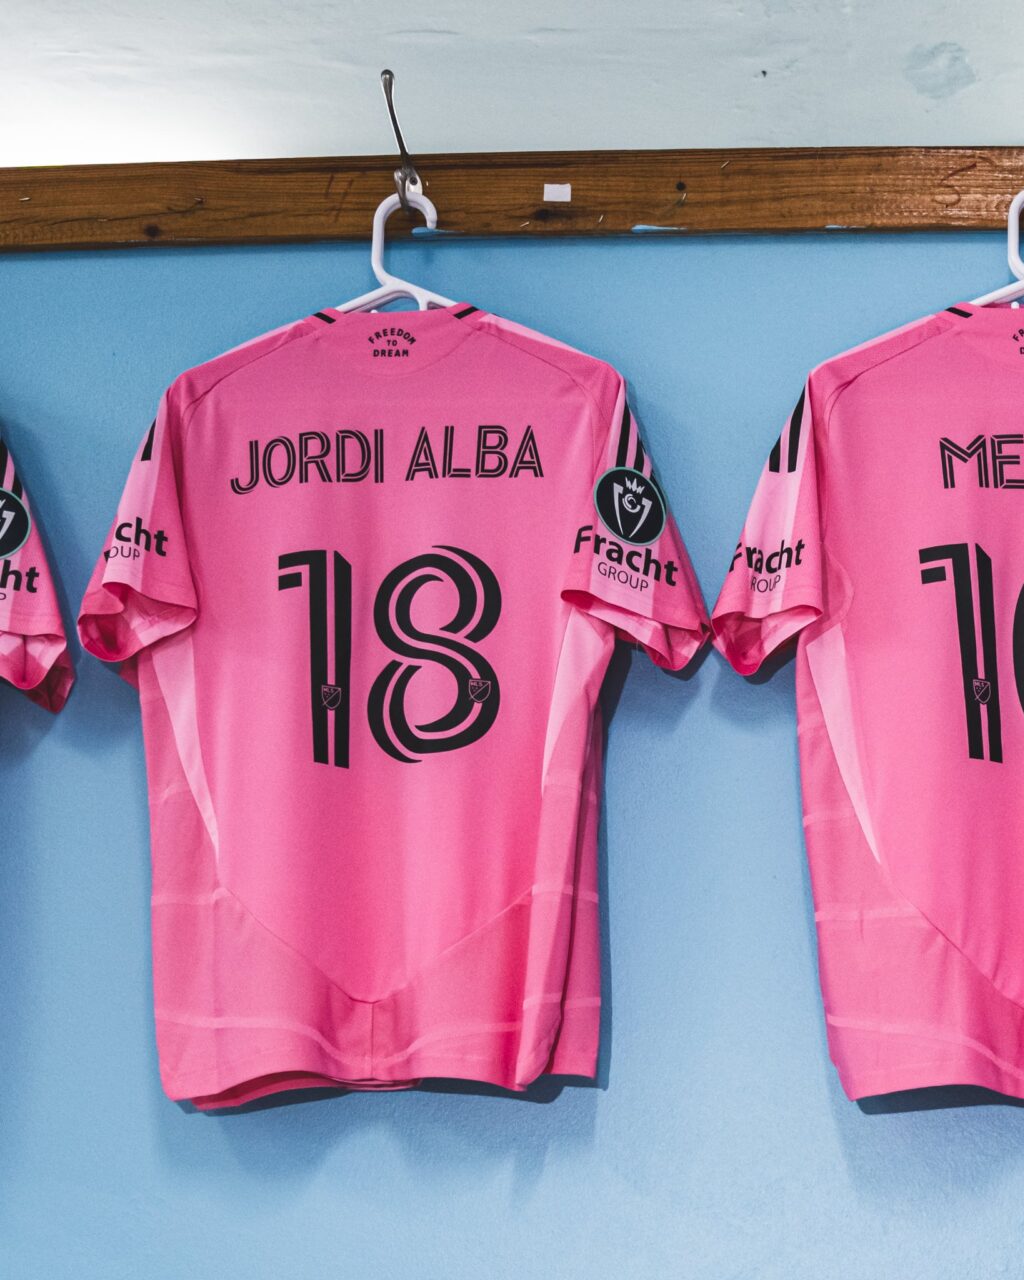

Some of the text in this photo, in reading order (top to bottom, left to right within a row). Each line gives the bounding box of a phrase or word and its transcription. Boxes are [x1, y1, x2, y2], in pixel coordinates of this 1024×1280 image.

[368, 328, 416, 345] FREEDOM
[373, 349, 409, 357] DREAM
[230, 424, 545, 495] JORDI ALBA
[573, 525, 678, 586] Fracht
[598, 561, 648, 591] GROUP
[750, 574, 781, 593] ROUP
[279, 545, 501, 769] 18
